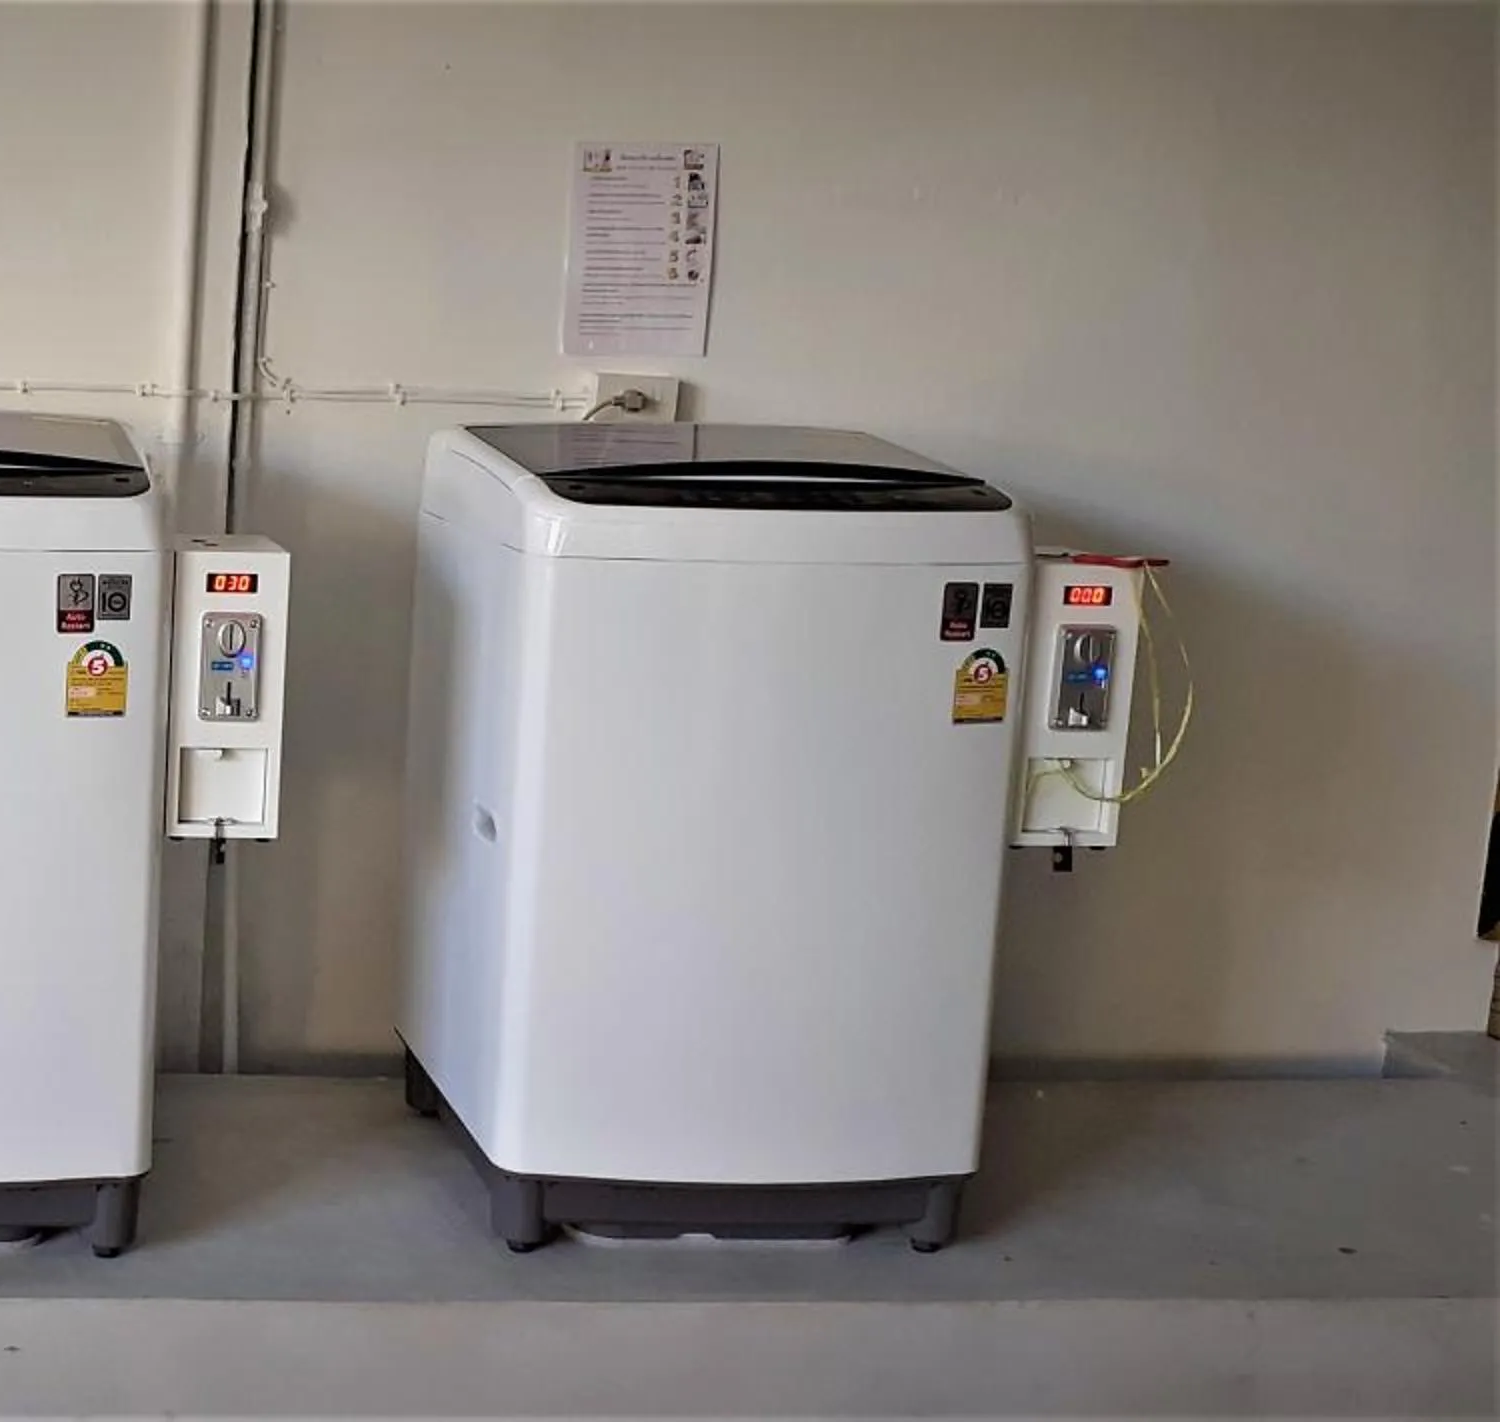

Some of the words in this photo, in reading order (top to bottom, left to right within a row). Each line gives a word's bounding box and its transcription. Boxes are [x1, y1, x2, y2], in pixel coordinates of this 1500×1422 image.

[214, 575, 250, 591] 030
[1069, 587, 1105, 603] 000
[91, 659, 105, 674] 5
